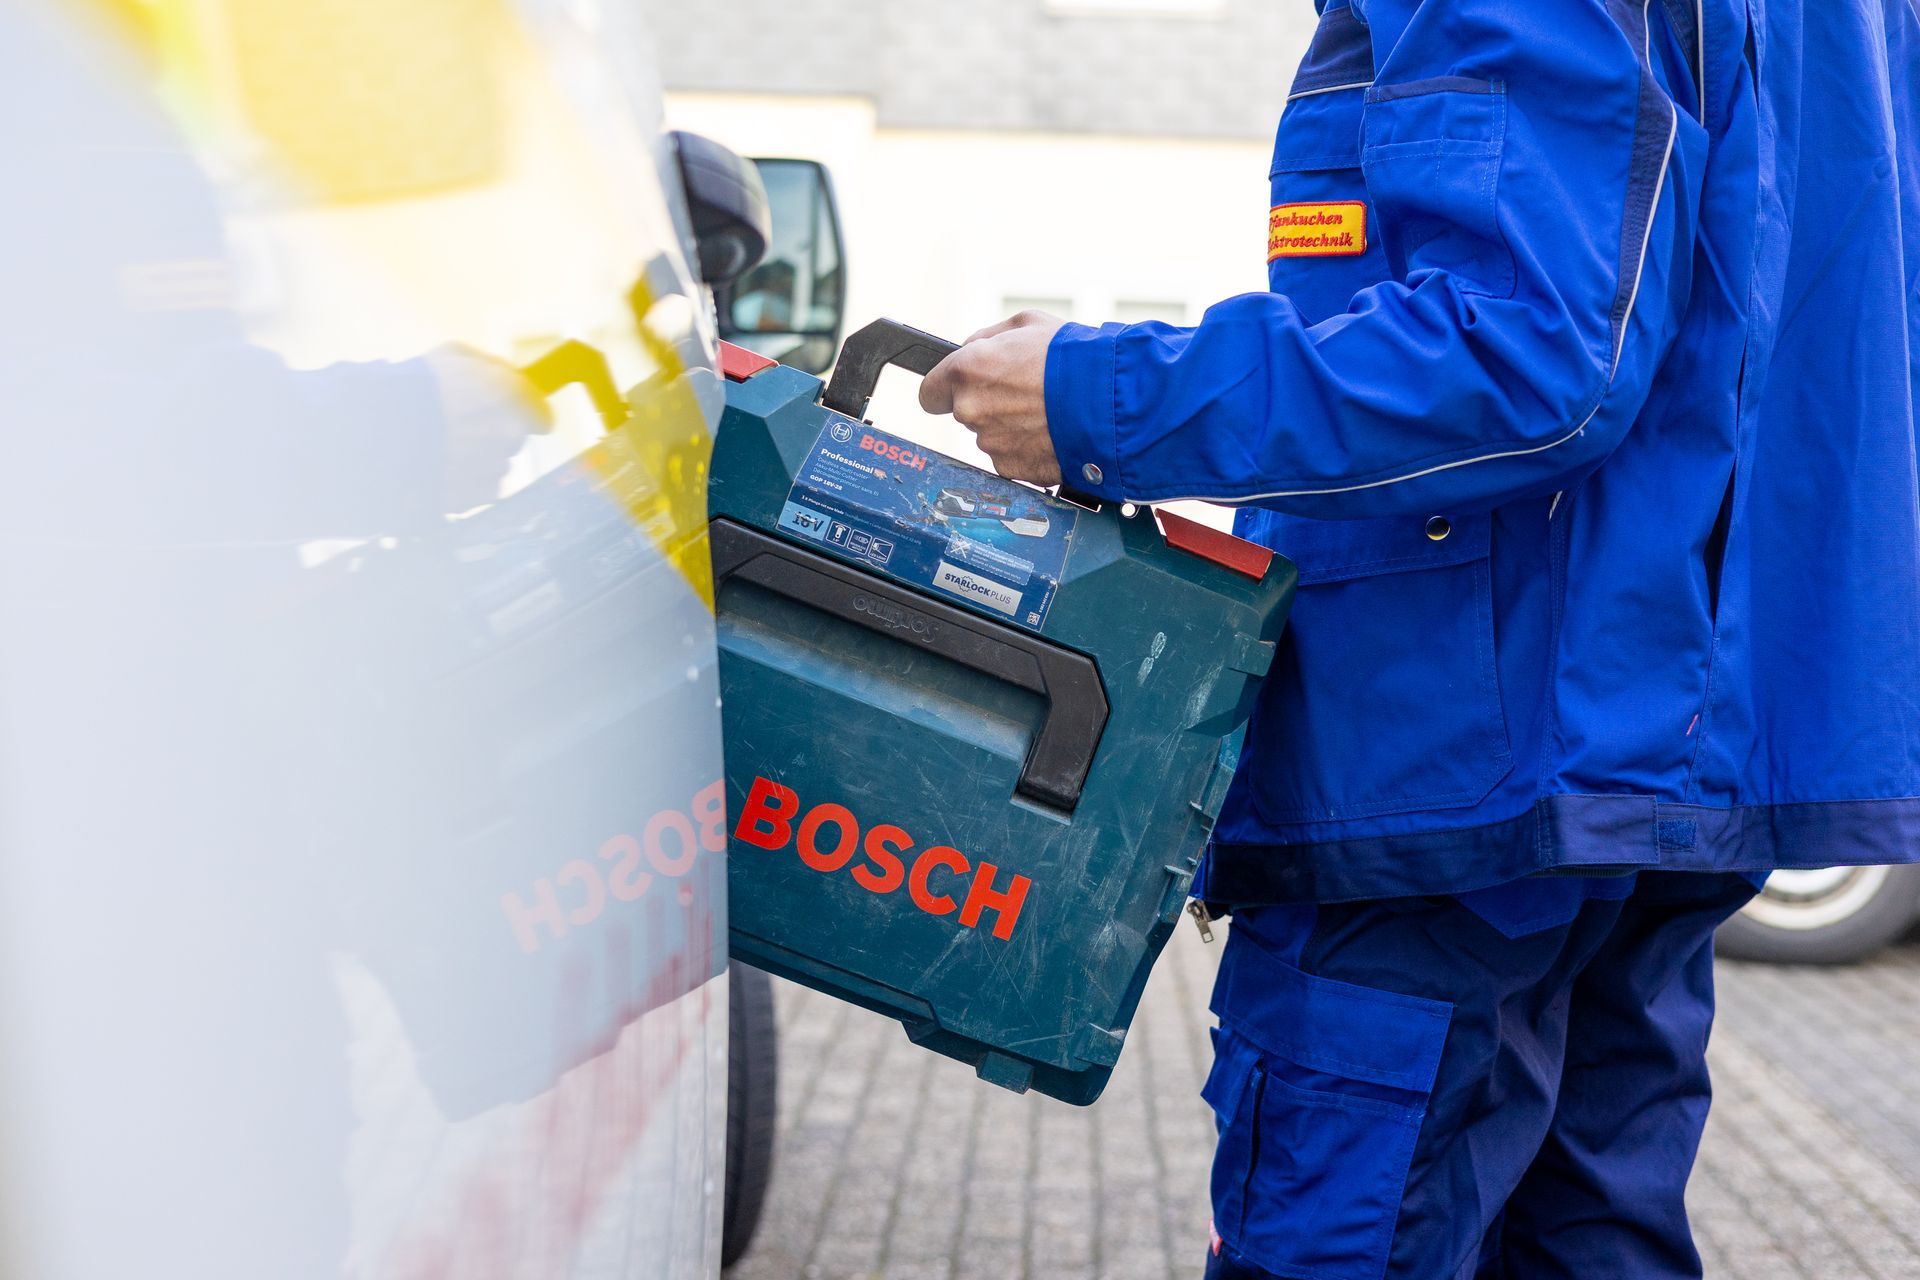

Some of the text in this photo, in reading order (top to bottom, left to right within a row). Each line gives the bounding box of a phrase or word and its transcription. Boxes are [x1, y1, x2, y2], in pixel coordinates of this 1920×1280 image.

[820, 448, 874, 474] Professional
[860, 434, 926, 472] BOSCH
[809, 474, 823, 483] GOP
[734, 776, 1032, 941] BOSCH
